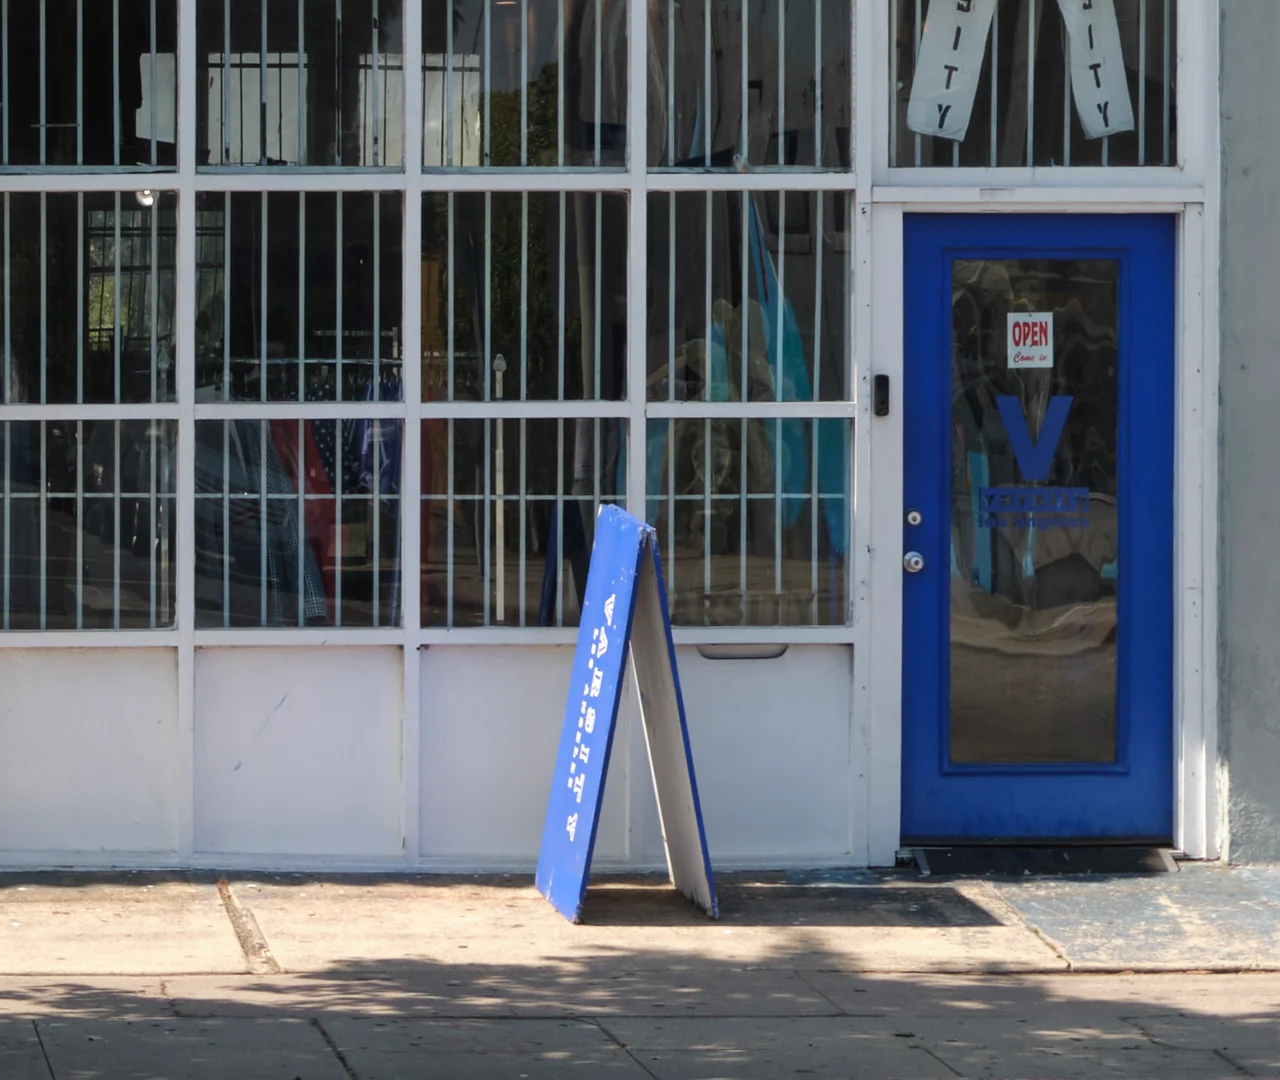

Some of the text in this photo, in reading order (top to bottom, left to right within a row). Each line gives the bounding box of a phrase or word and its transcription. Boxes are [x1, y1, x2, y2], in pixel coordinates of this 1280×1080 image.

[1012, 321, 1049, 347] OPEN
[1013, 351, 1048, 363] Come in
[994, 395, 1075, 481] V
[566, 593, 617, 842] VARSITY
